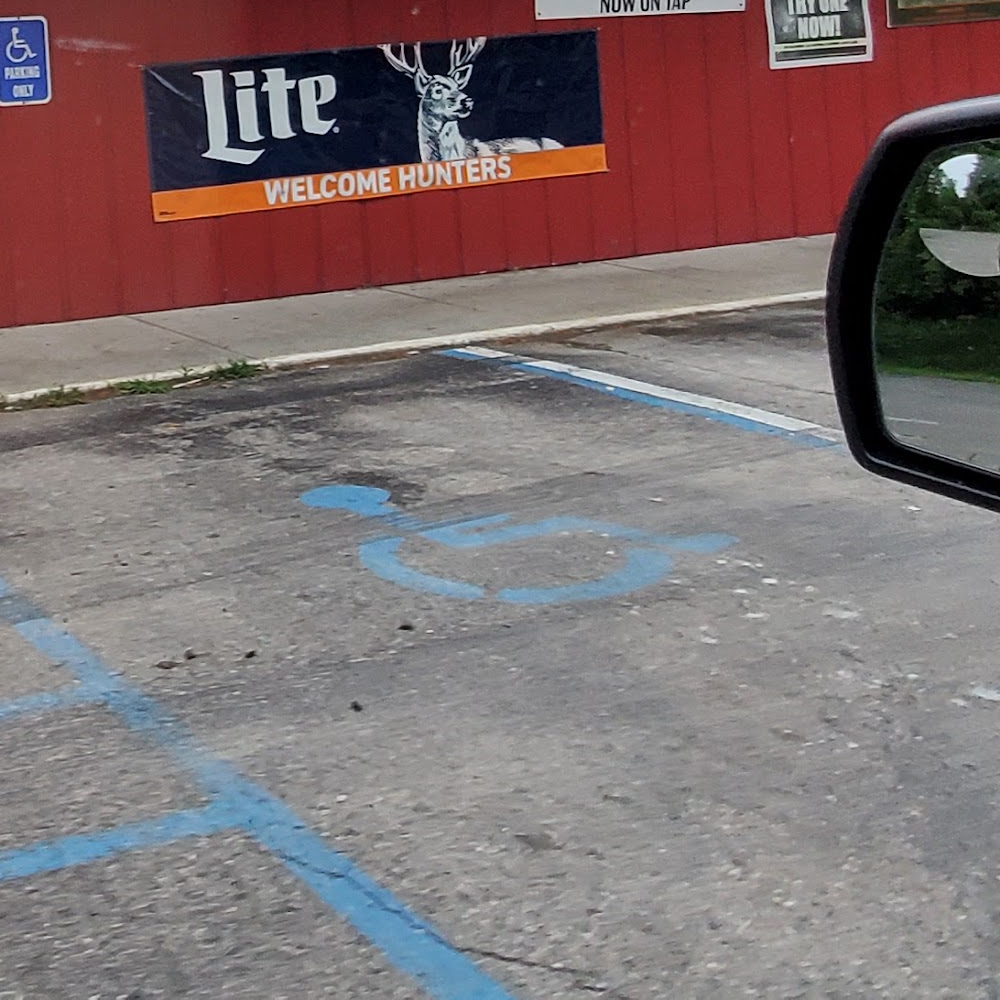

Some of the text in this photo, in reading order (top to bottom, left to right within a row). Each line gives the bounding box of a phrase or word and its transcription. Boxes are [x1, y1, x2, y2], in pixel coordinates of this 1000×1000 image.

[797, 14, 842, 39] NOW!
[4, 65, 40, 80] PARKING
[12, 83, 34, 98] ONLY
[192, 67, 338, 165] Lite
[263, 156, 512, 206] WELCOME HUNTERS
